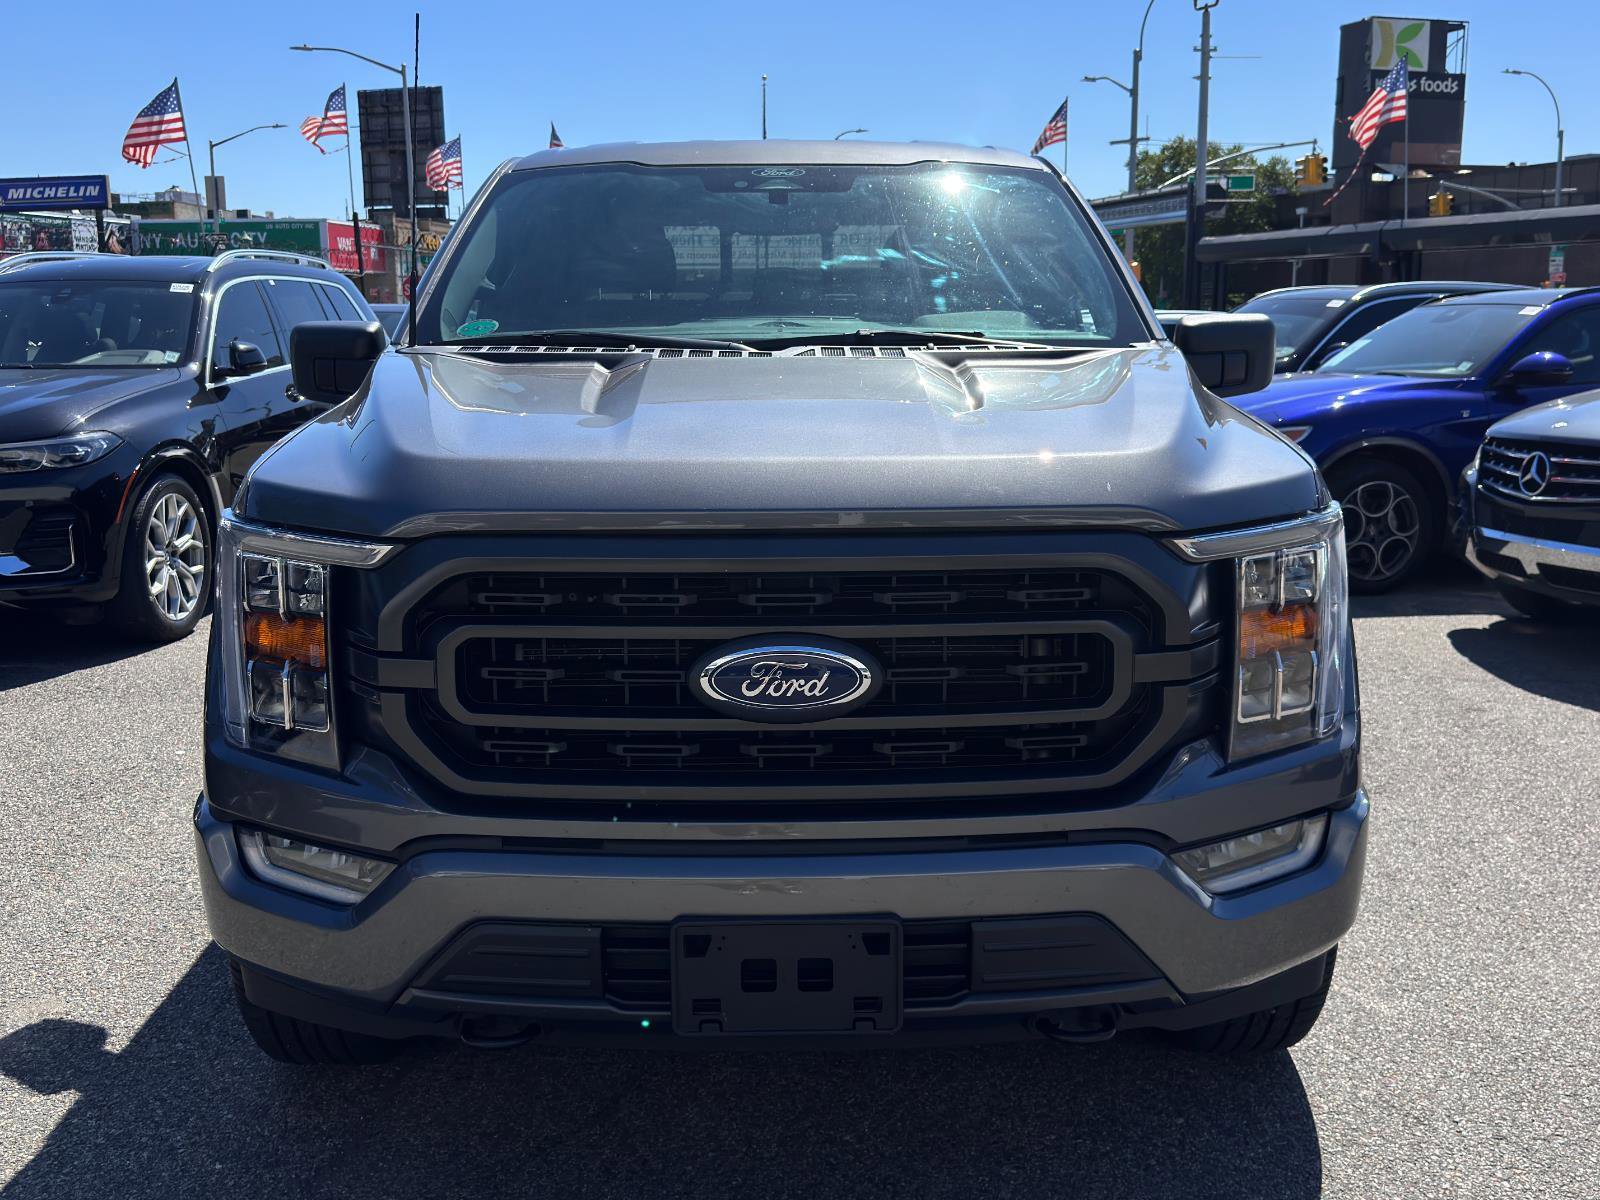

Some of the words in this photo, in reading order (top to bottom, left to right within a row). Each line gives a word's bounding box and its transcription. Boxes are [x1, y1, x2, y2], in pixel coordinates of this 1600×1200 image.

[1420, 76, 1459, 94] foods
[760, 168, 797, 177] Ford
[8, 185, 100, 199] MICHELIN
[139, 233, 162, 249] NY
[230, 231, 268, 248] CTY
[741, 661, 830, 697] Ford
